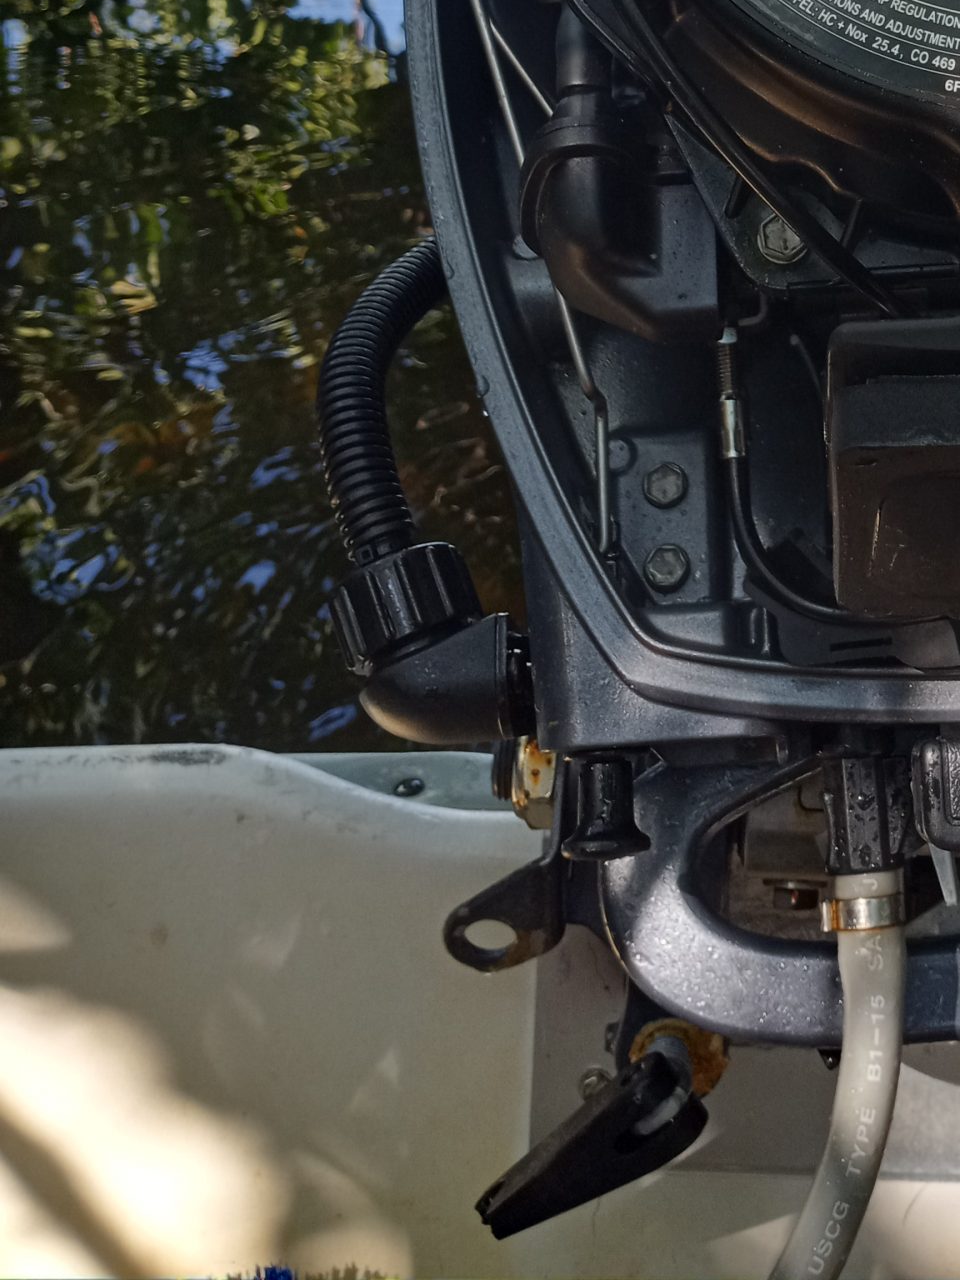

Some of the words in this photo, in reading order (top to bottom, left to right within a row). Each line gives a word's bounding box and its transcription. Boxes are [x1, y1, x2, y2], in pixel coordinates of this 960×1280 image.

[817, 8, 837, 26] HC
[910, 48, 930, 64] CO
[931, 55, 956, 71] 469
[859, 8, 886, 27] AND
[808, 1202, 850, 1275] USCG
[846, 1108, 876, 1176] TYPE
